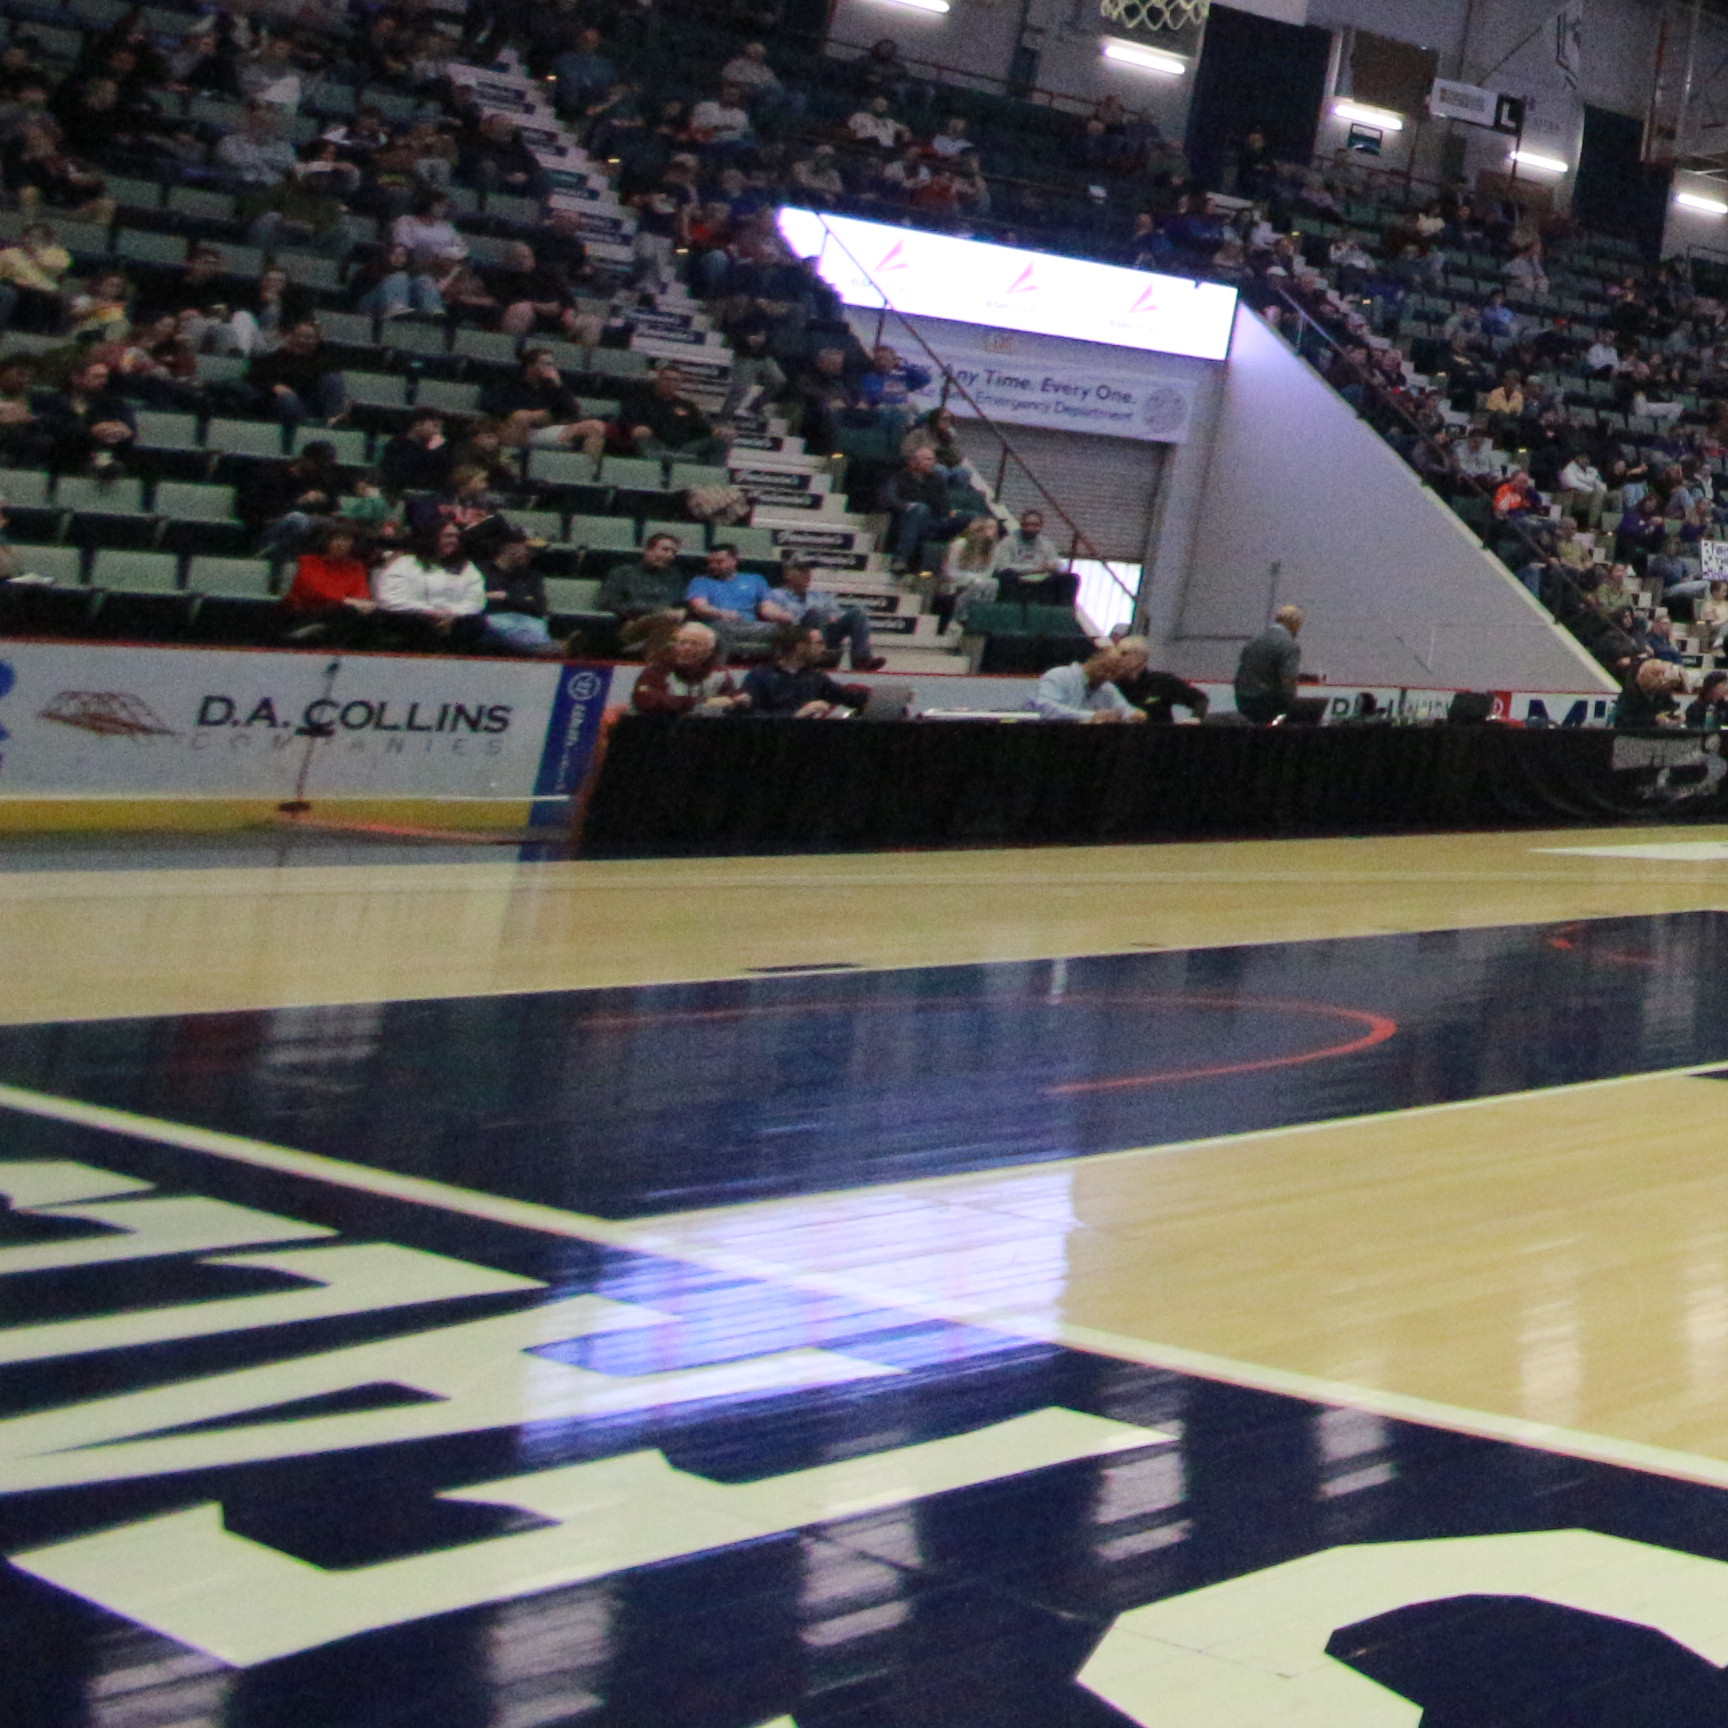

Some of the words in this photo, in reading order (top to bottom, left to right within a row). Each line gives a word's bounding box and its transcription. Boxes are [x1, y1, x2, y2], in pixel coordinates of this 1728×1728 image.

[984, 369, 1035, 391] Time.
[1040, 378, 1092, 401] Every
[1095, 385, 1137, 405] One.
[1054, 400, 1134, 422] Department
[195, 694, 290, 728] D.A.
[303, 697, 514, 733] COLLINS
